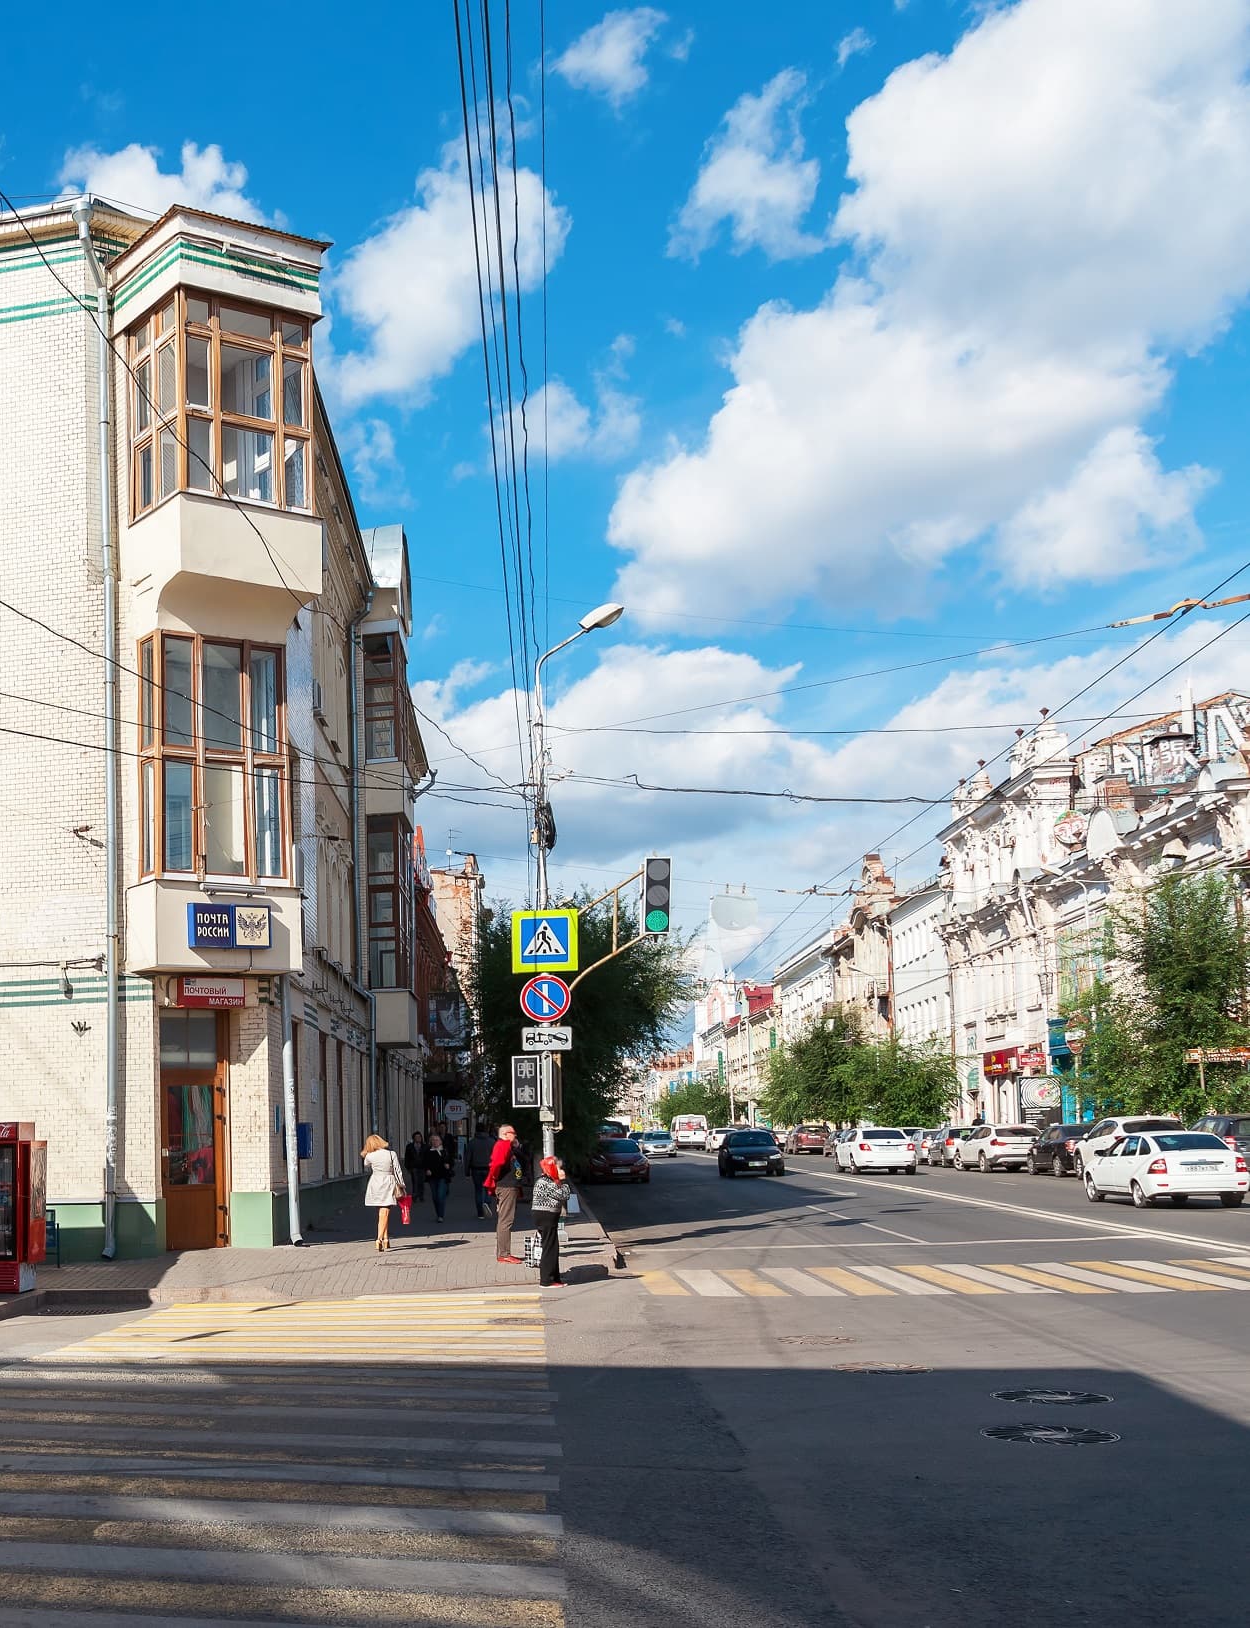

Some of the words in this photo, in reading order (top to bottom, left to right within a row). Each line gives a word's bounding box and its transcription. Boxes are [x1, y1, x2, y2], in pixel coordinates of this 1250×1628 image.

[197, 913, 229, 924] ПОЧТА
[197, 926, 230, 938] РОССИИ
[184, 985, 227, 995] ПОЧТОВЫЙ
[208, 997, 244, 1006] МАГАЗИН
